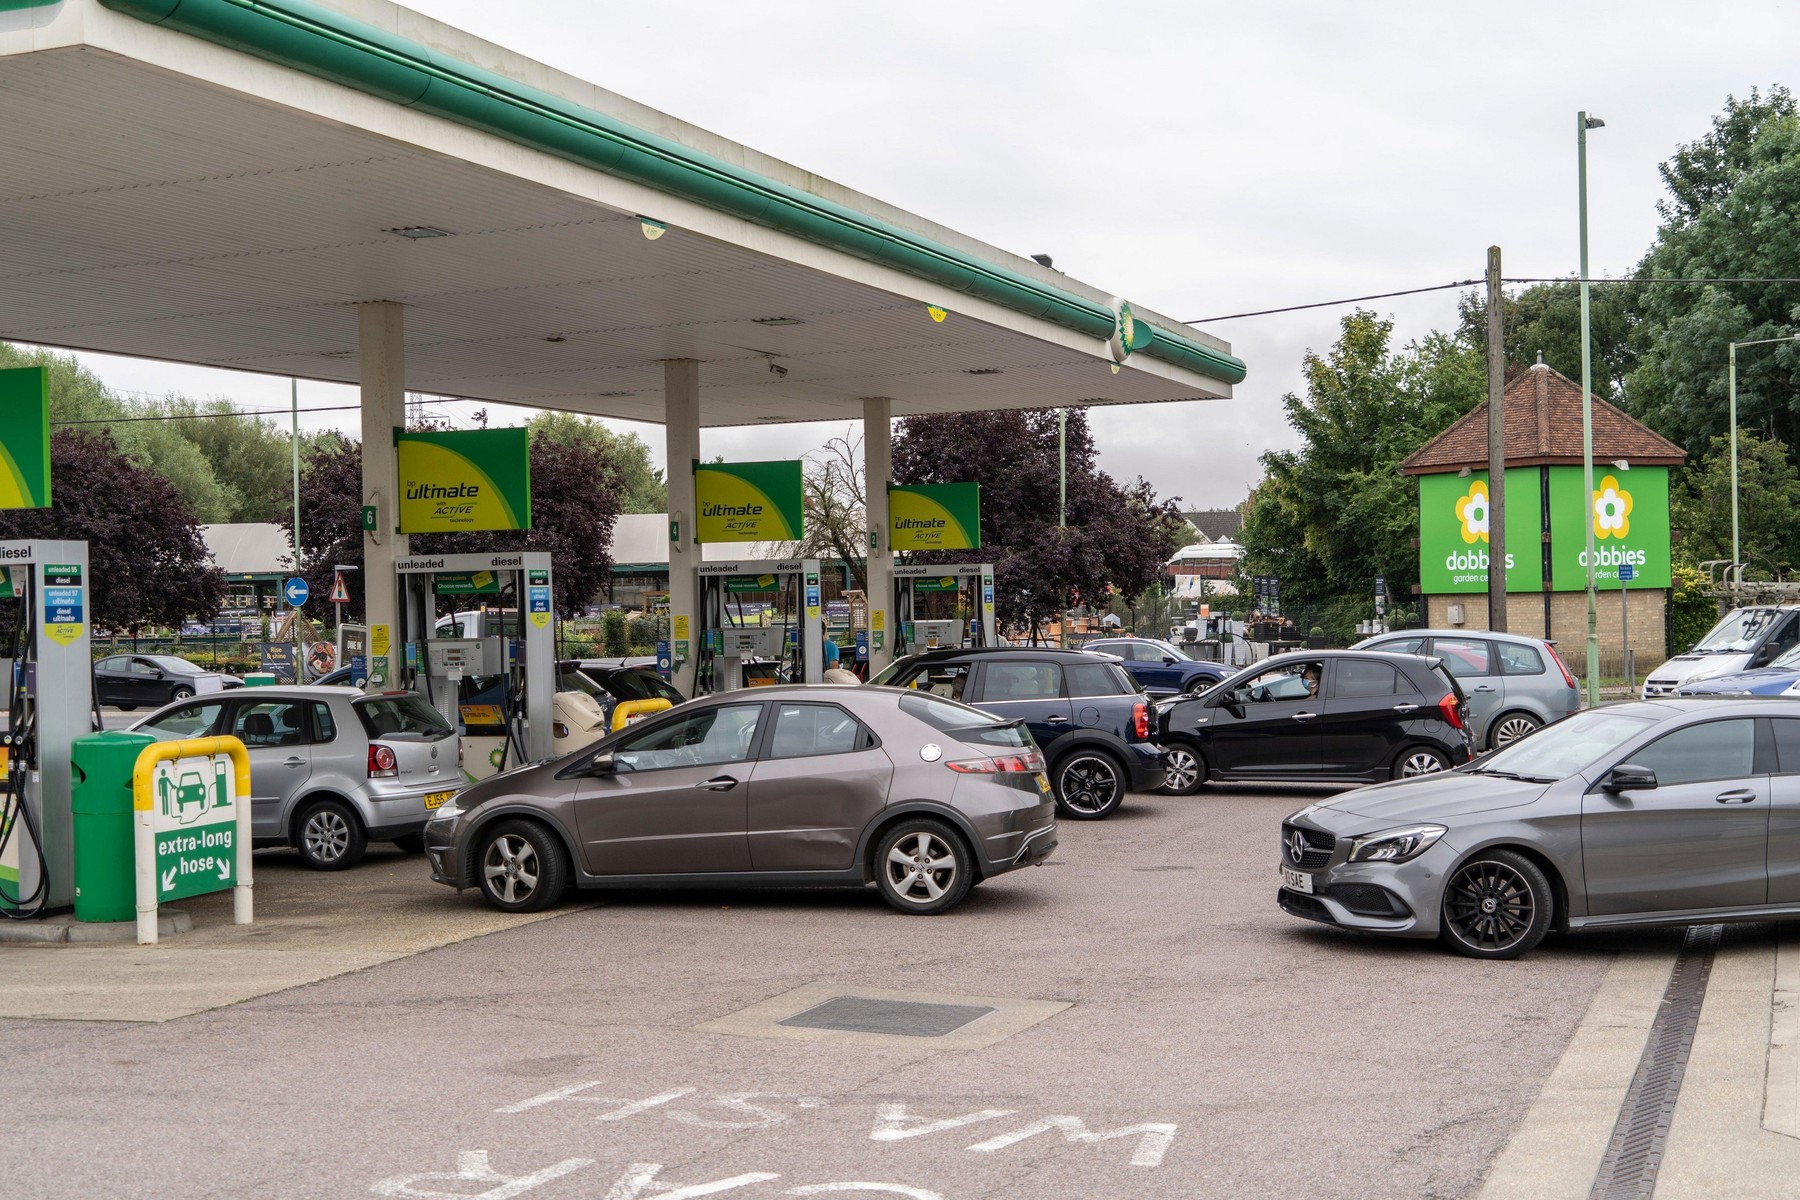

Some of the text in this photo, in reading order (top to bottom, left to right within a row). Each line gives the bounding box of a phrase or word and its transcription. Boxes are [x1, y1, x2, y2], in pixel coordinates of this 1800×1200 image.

[406, 482, 479, 500] ultimate
[433, 505, 473, 515] ACTIVE
[702, 503, 763, 517] ultimate
[367, 510, 373, 524] 6
[725, 521, 758, 529] ACTIVE
[895, 518, 946, 529] ultimate
[673, 525, 677, 537] 4
[871, 535, 876, 545] 2
[397, 556, 522, 569] unleaded diesel
[1446, 549, 1515, 570] dobbs
[699, 562, 802, 573] unleaded diesel
[959, 566, 981, 574] diesel
[1453, 572, 1479, 584] garden
[158, 830, 232, 855] extra-long
[180, 856, 214, 875] hose
